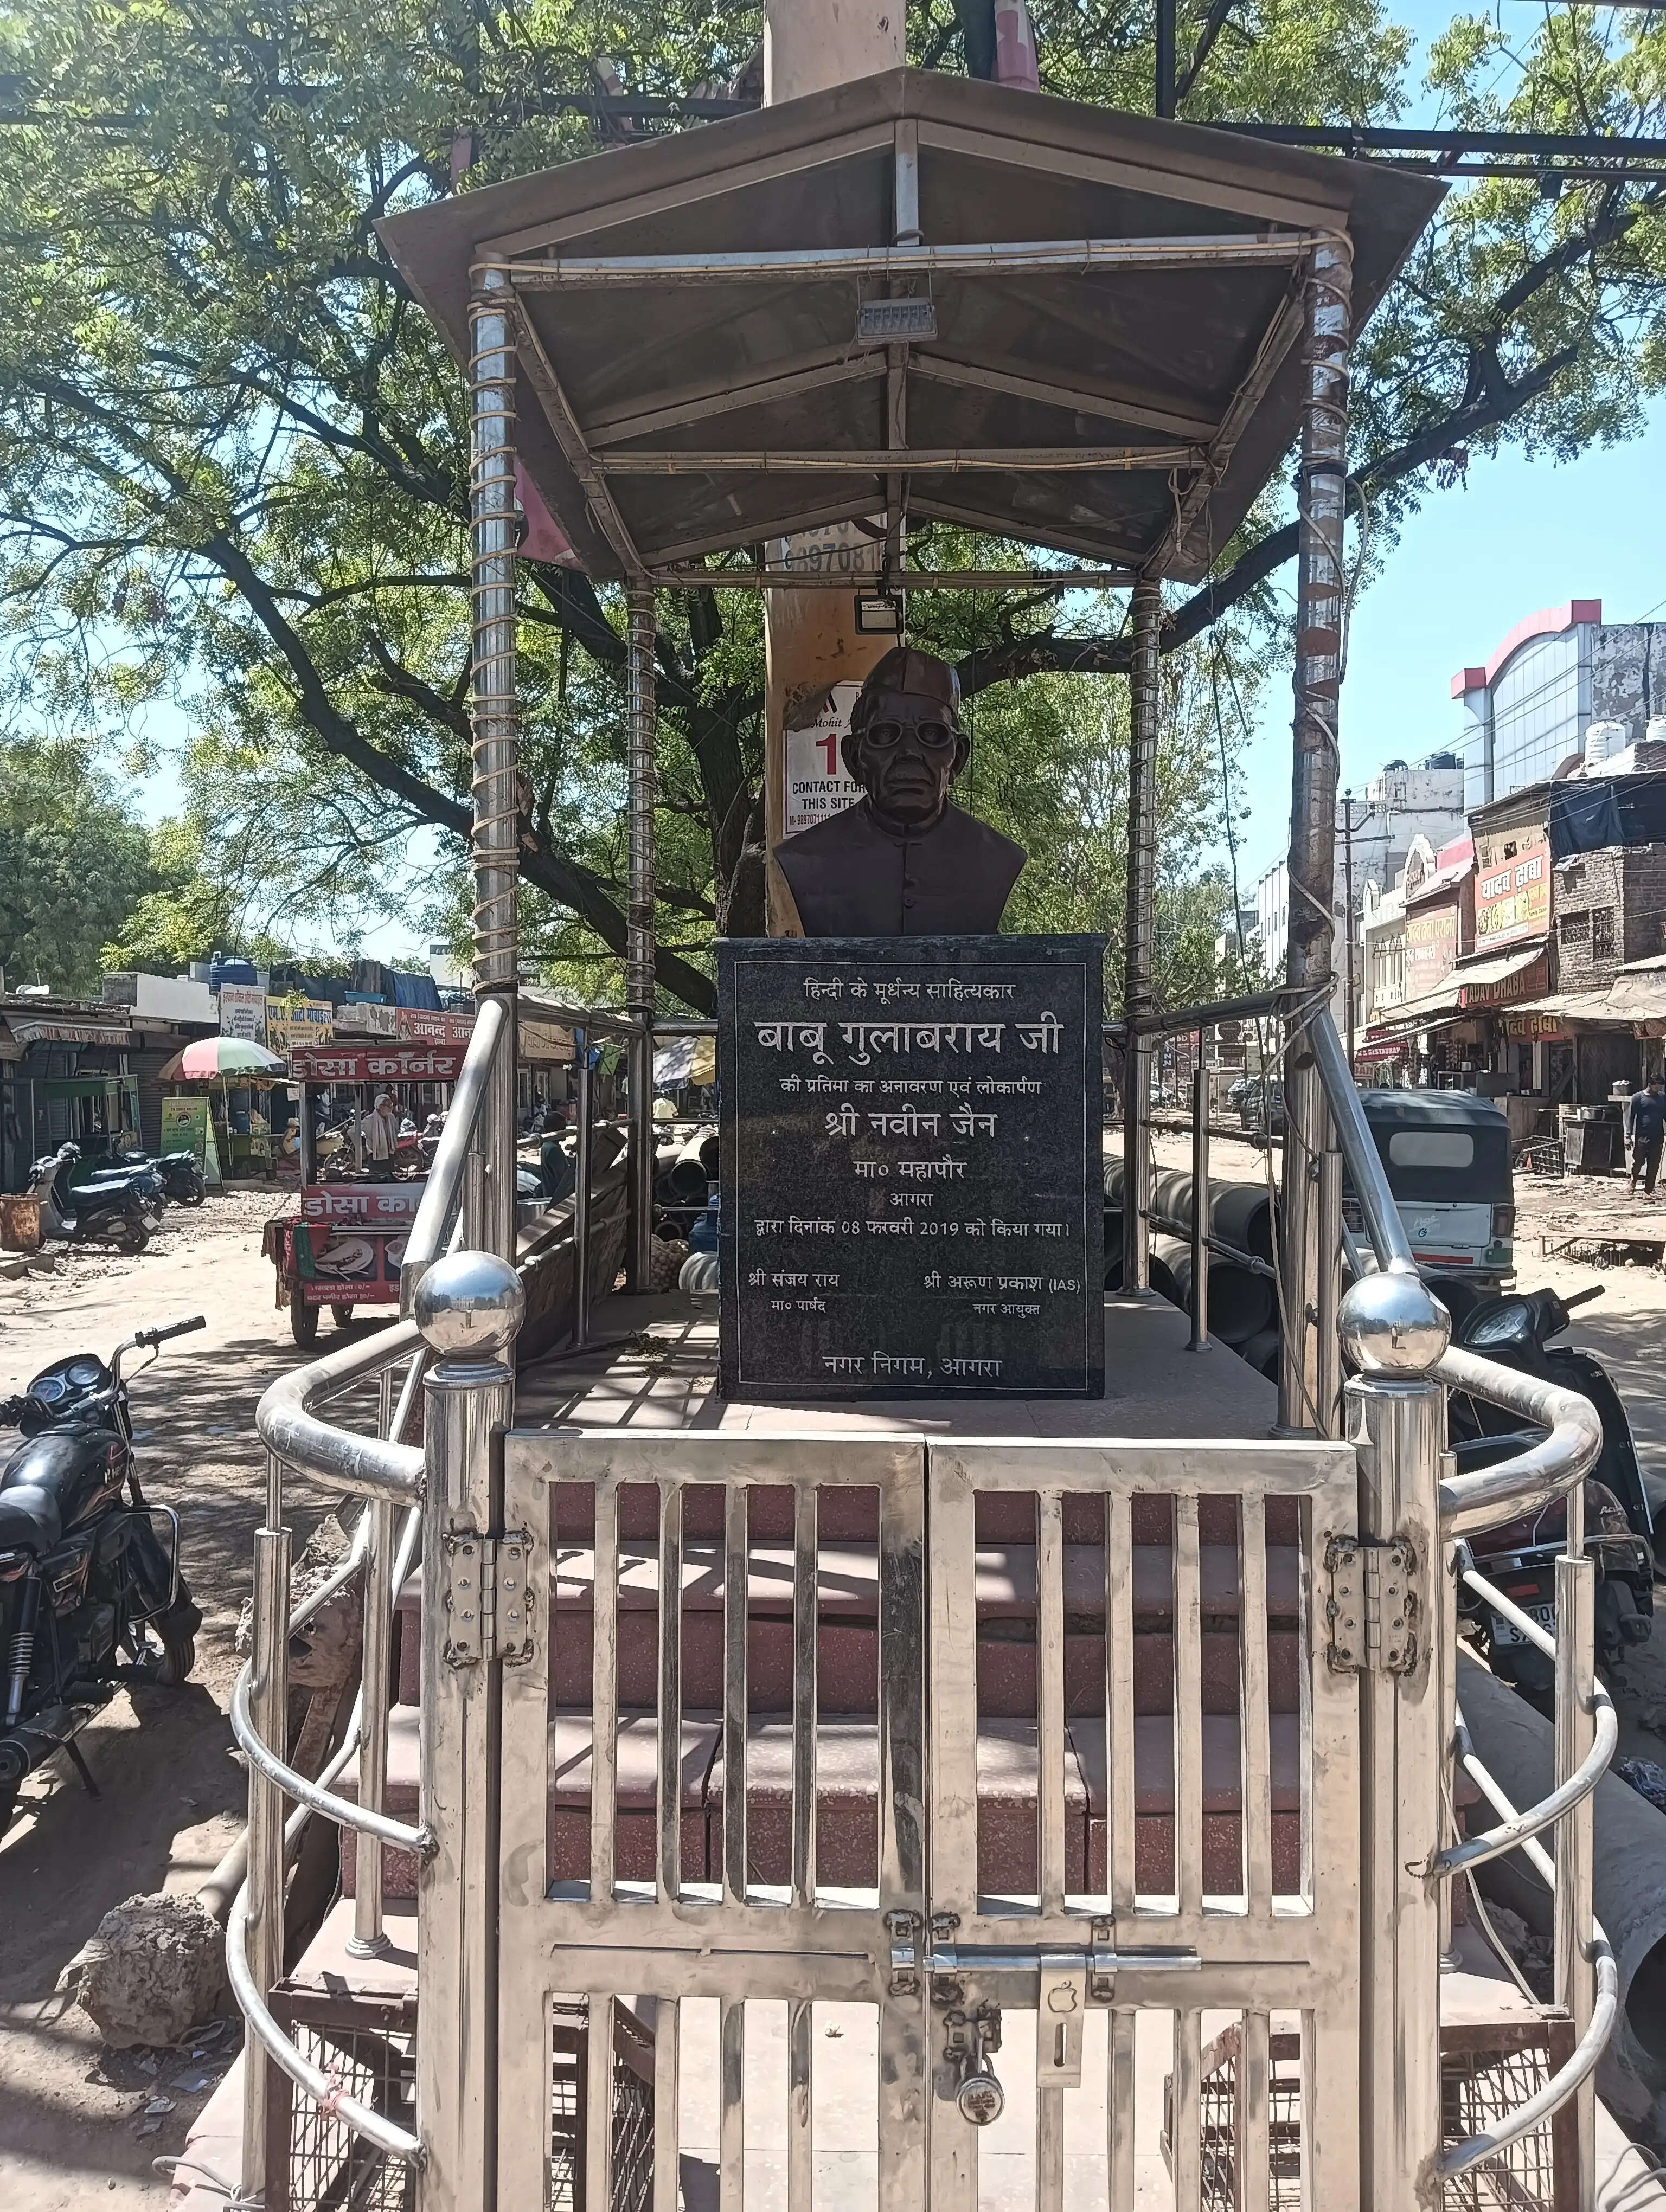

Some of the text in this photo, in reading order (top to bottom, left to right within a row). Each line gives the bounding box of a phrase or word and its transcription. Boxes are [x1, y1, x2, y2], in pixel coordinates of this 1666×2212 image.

[811, 717, 842, 729] Mohit
[792, 781, 866, 794] CONTACT FOR
[802, 797, 855, 810] THIS SITE
[1481, 869, 1513, 900] यादव
[804, 977, 1016, 1005] हिन्दी के मूर्धन्य साहित्यकार
[1493, 970, 1526, 1000] DHABA
[413, 1021, 446, 1037] आनन्द
[754, 1011, 1065, 1065] बाबू गुलाबराय जी
[293, 1050, 457, 1078] डोसा कॉर्नर
[779, 1073, 1043, 1098] की प्रतिमा का अनावरण एवं लोकार्पण
[824, 1102, 999, 1137] श्री नवीन जैन
[898, 1155, 968, 1182] महापौर
[303, 1190, 419, 1216] डोसा का
[889, 1192, 934, 1207] आगरा
[754, 1219, 785, 1236] द्वारा
[787, 1216, 836, 1236] दिनांक
[842, 1221, 860, 1235] 08
[865, 1217, 914, 1236] फरवरी
[919, 1221, 959, 1236] 2019
[965, 1218, 985, 1237] को
[991, 1219, 1029, 1237] किया
[748, 1268, 840, 1287] श्री संजय राय
[924, 1270, 942, 1289] श्री
[997, 1276, 1043, 1292] प्रकाश
[1049, 1278, 1081, 1294] (IAS)
[796, 1296, 826, 1313] पार्षद
[973, 1303, 1041, 1320] नगर आयुक्त
[822, 1350, 1003, 1380] नगर निगम, आगरा
